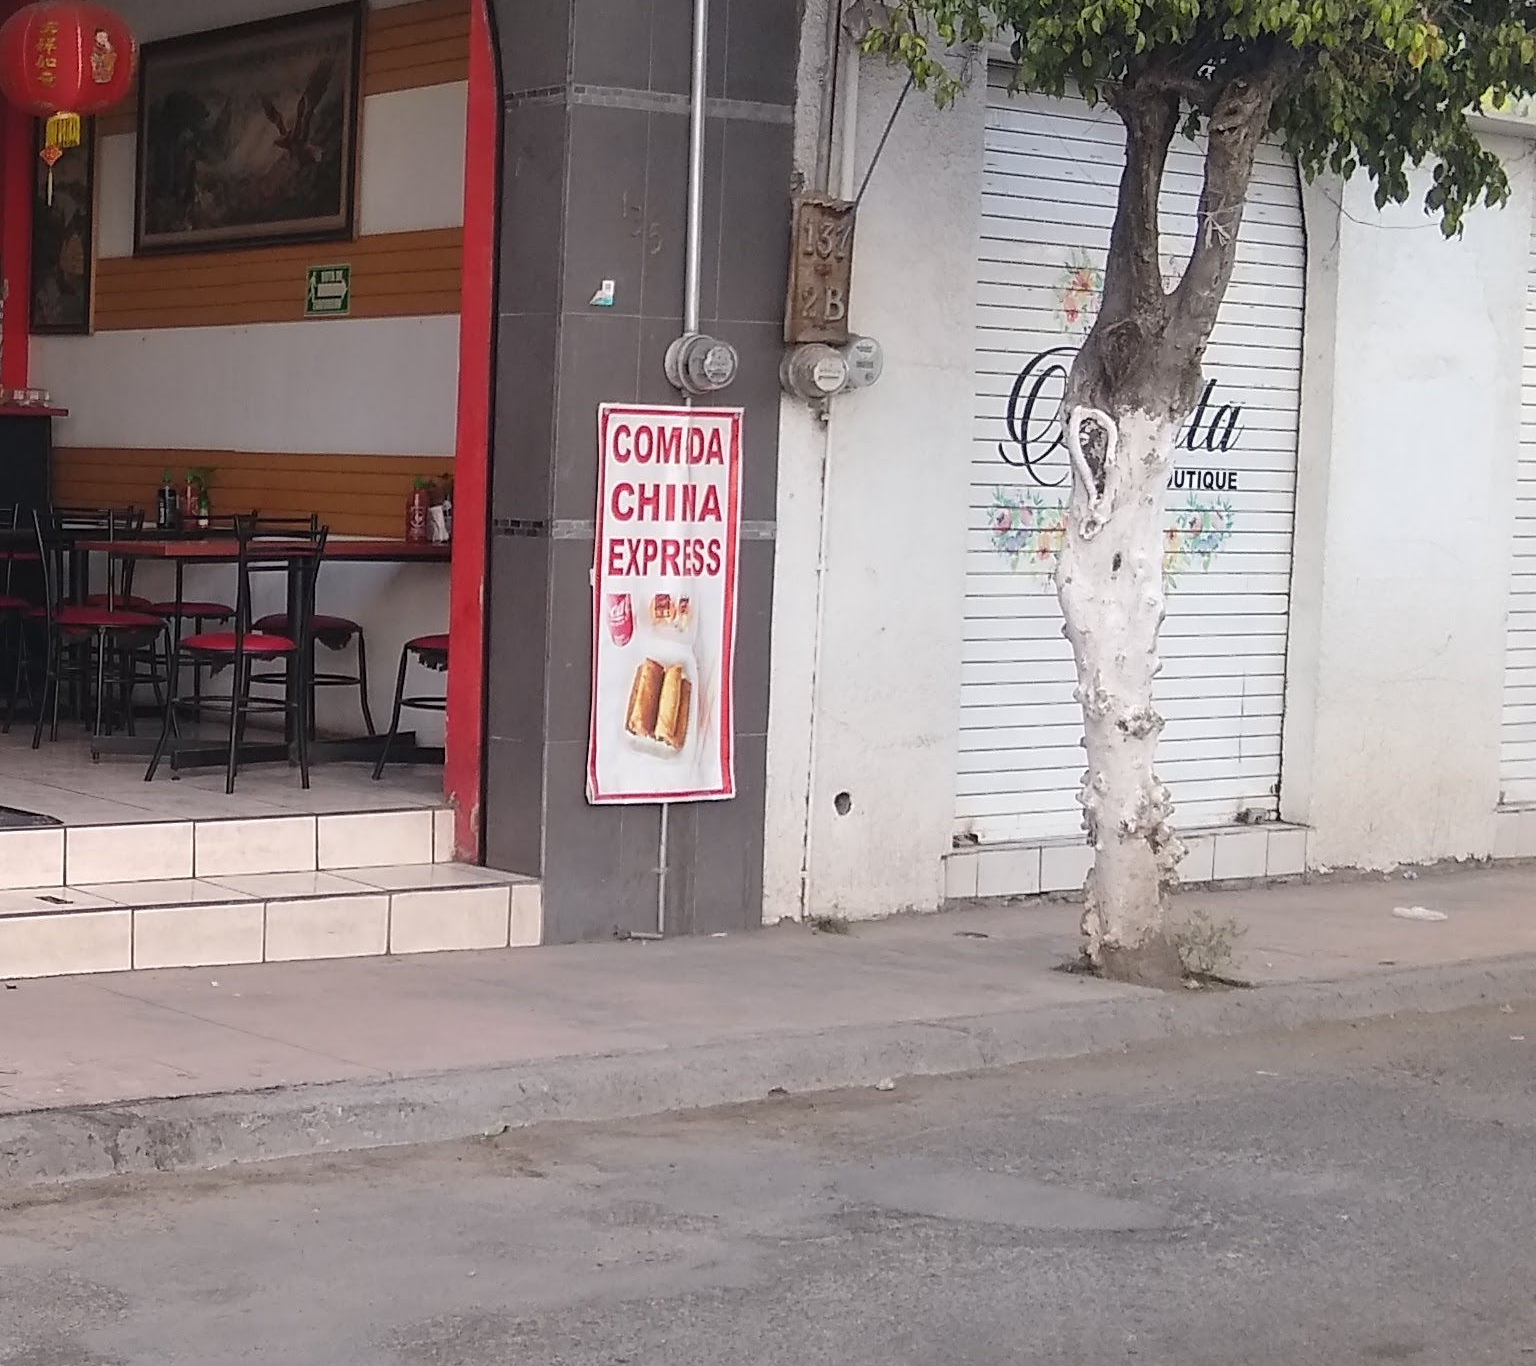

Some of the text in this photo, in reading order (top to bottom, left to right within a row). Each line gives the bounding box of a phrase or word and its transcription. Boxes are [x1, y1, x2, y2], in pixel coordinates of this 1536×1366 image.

[612, 424, 725, 466] COMDA
[1167, 470, 1238, 490] UTIQUE
[611, 483, 722, 523] CHINA
[607, 538, 721, 577] EXPRESS
